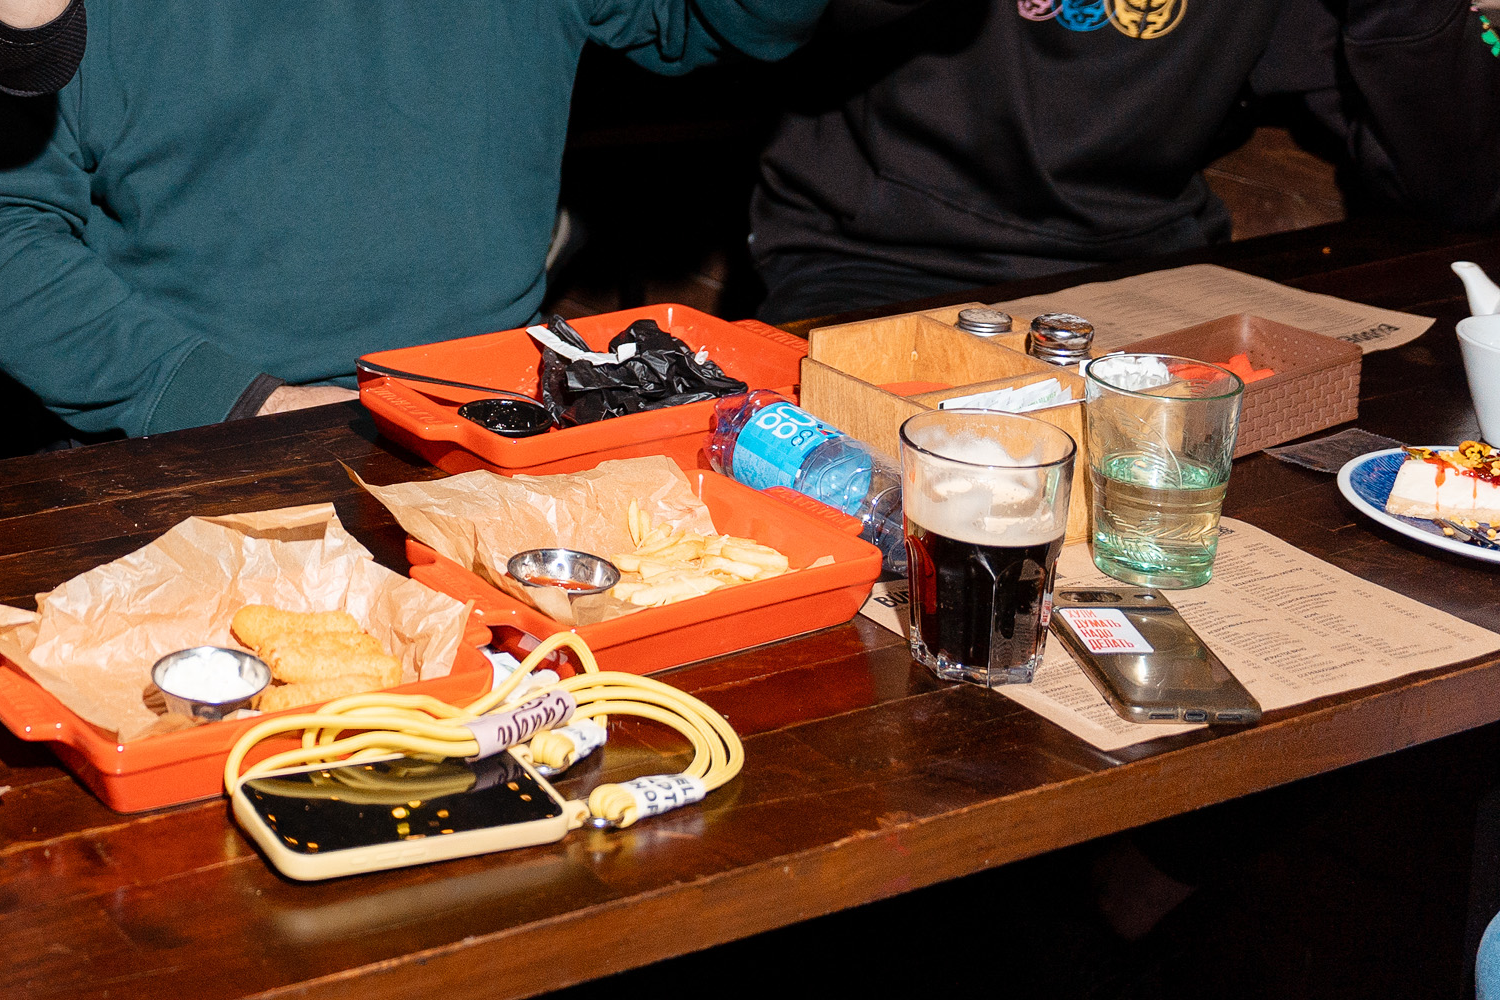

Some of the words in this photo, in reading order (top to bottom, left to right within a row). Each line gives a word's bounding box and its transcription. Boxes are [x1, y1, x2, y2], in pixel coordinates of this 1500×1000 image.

[1073, 619, 1122, 629] ДУМАТЬ
[1079, 629, 1114, 639] НАДО
[1088, 638, 1135, 651] ДЕЛАТЬ
